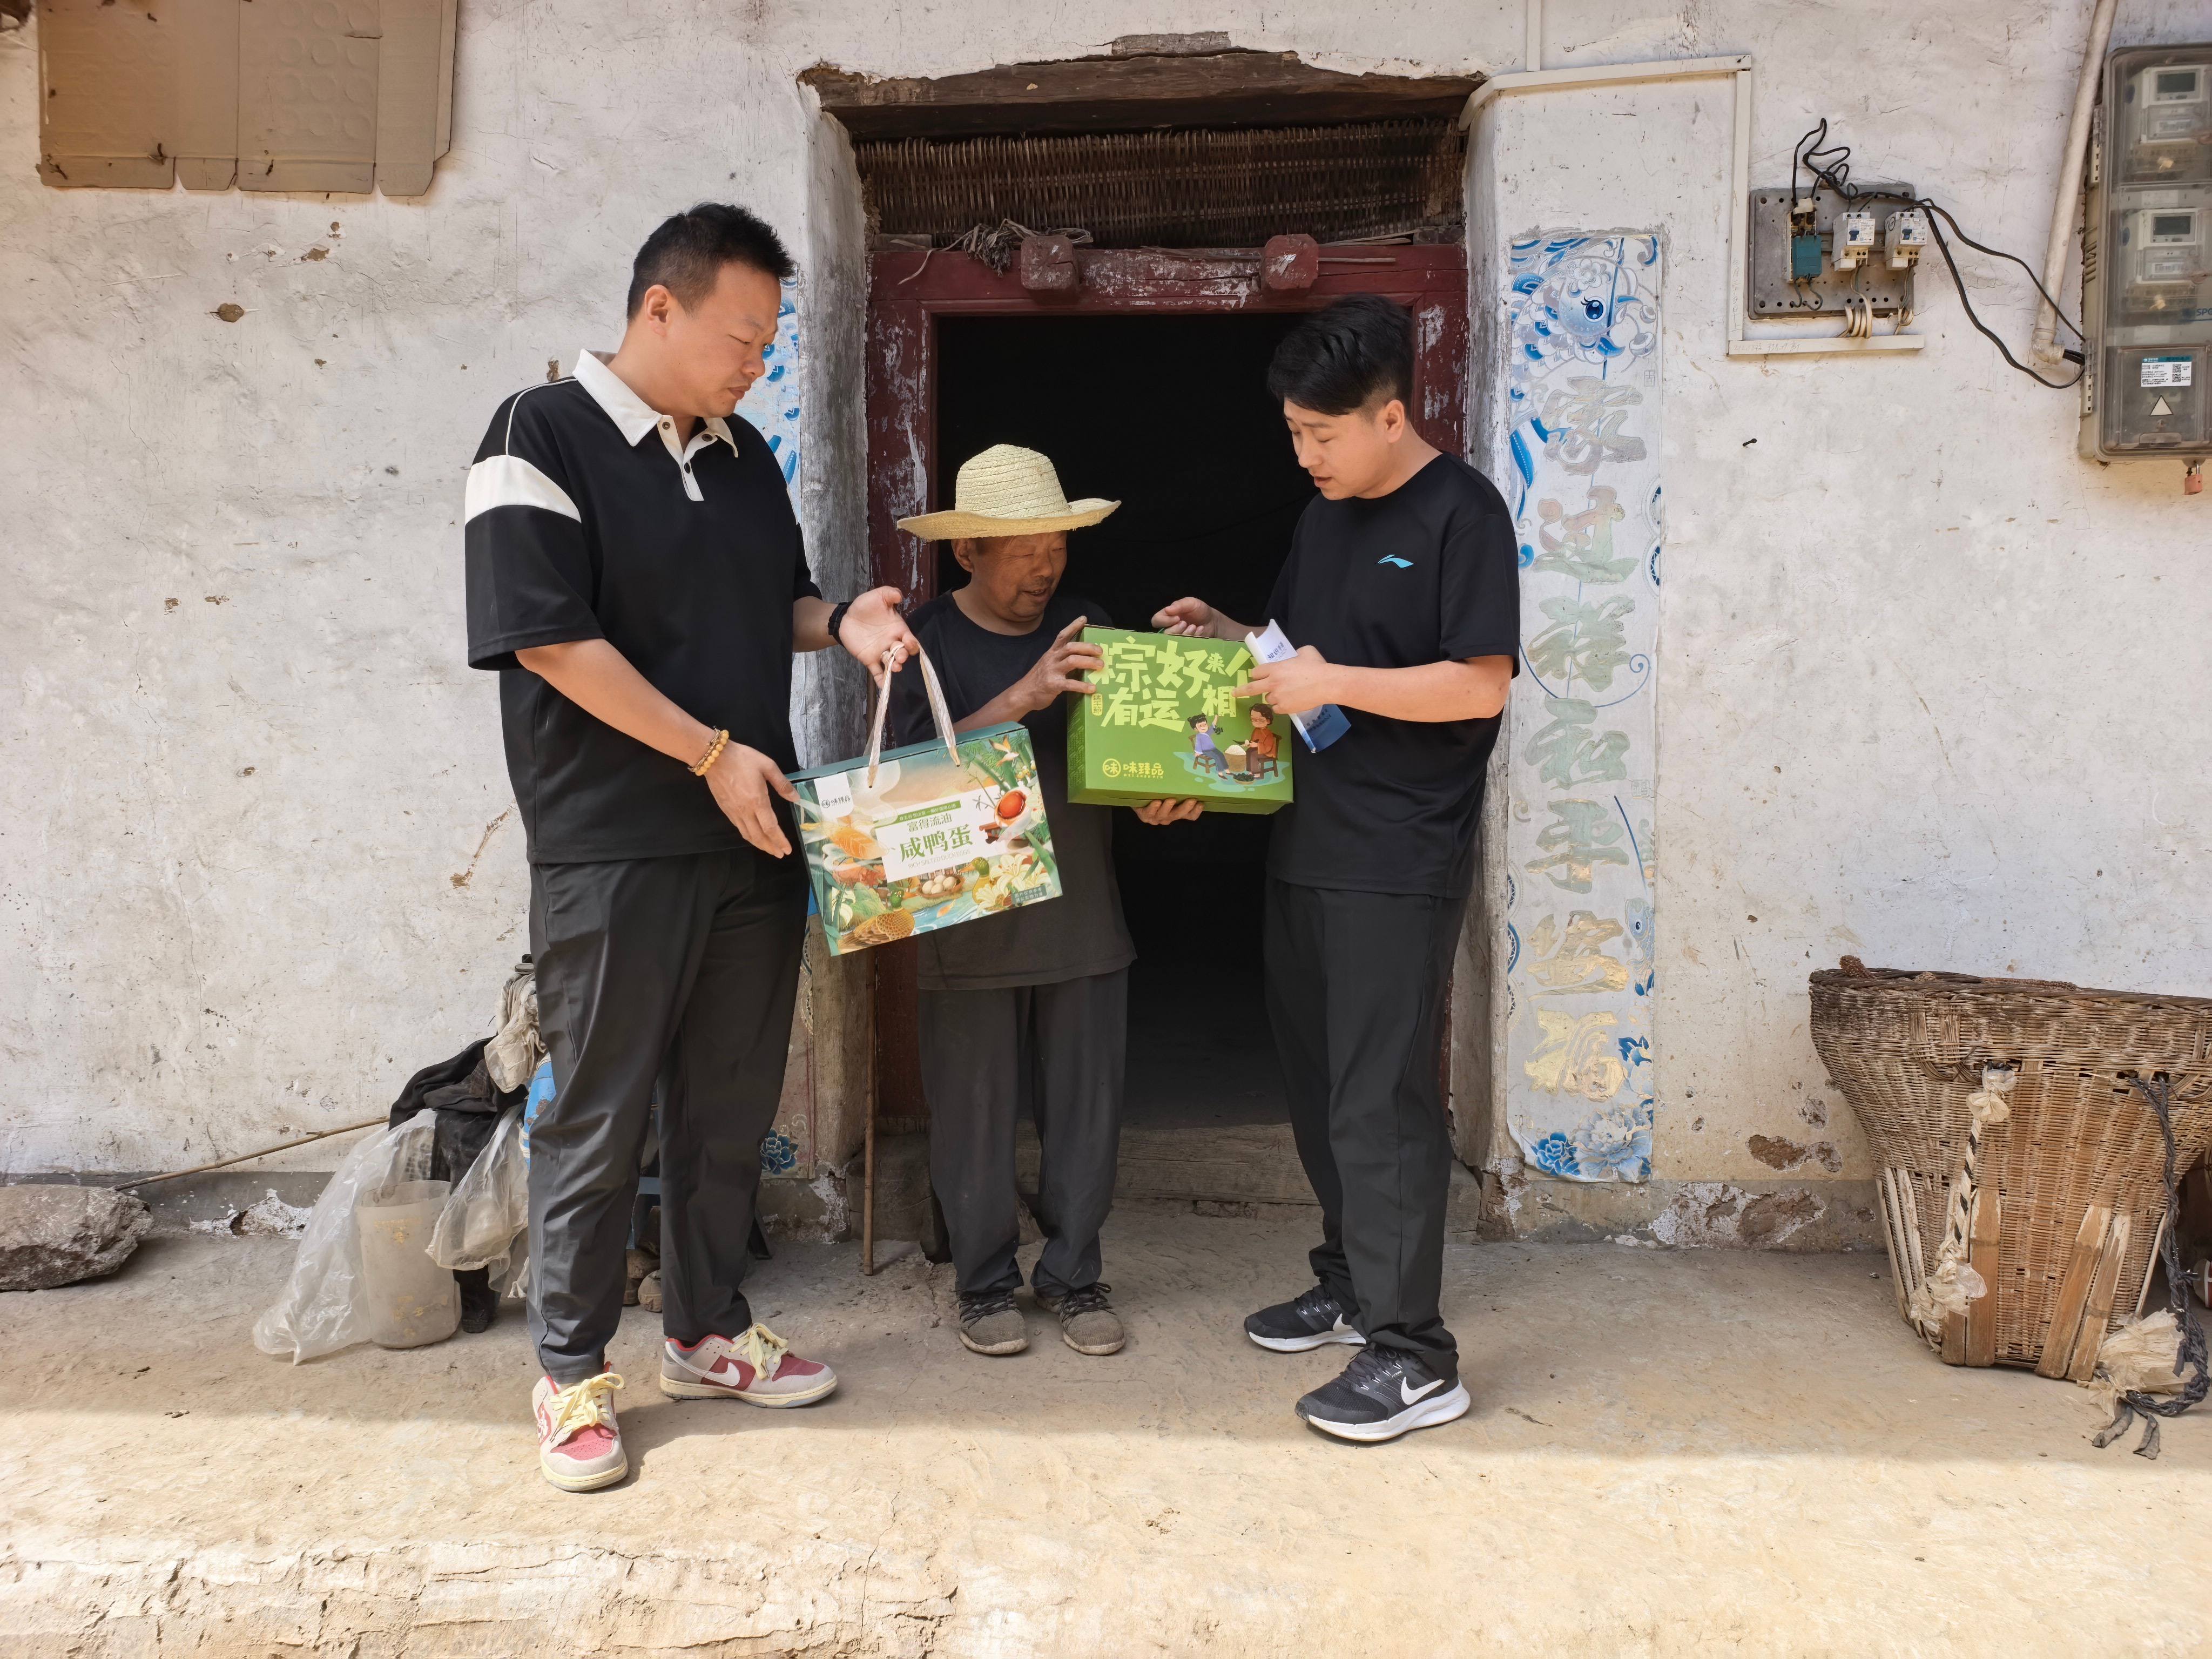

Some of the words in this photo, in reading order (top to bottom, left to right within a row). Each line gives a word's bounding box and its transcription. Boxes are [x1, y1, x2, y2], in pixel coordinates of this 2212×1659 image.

[1123, 761, 1164, 775] 味臻品
[907, 813, 952, 832] 富得流油
[900, 824, 973, 862] 咸鸭蛋
